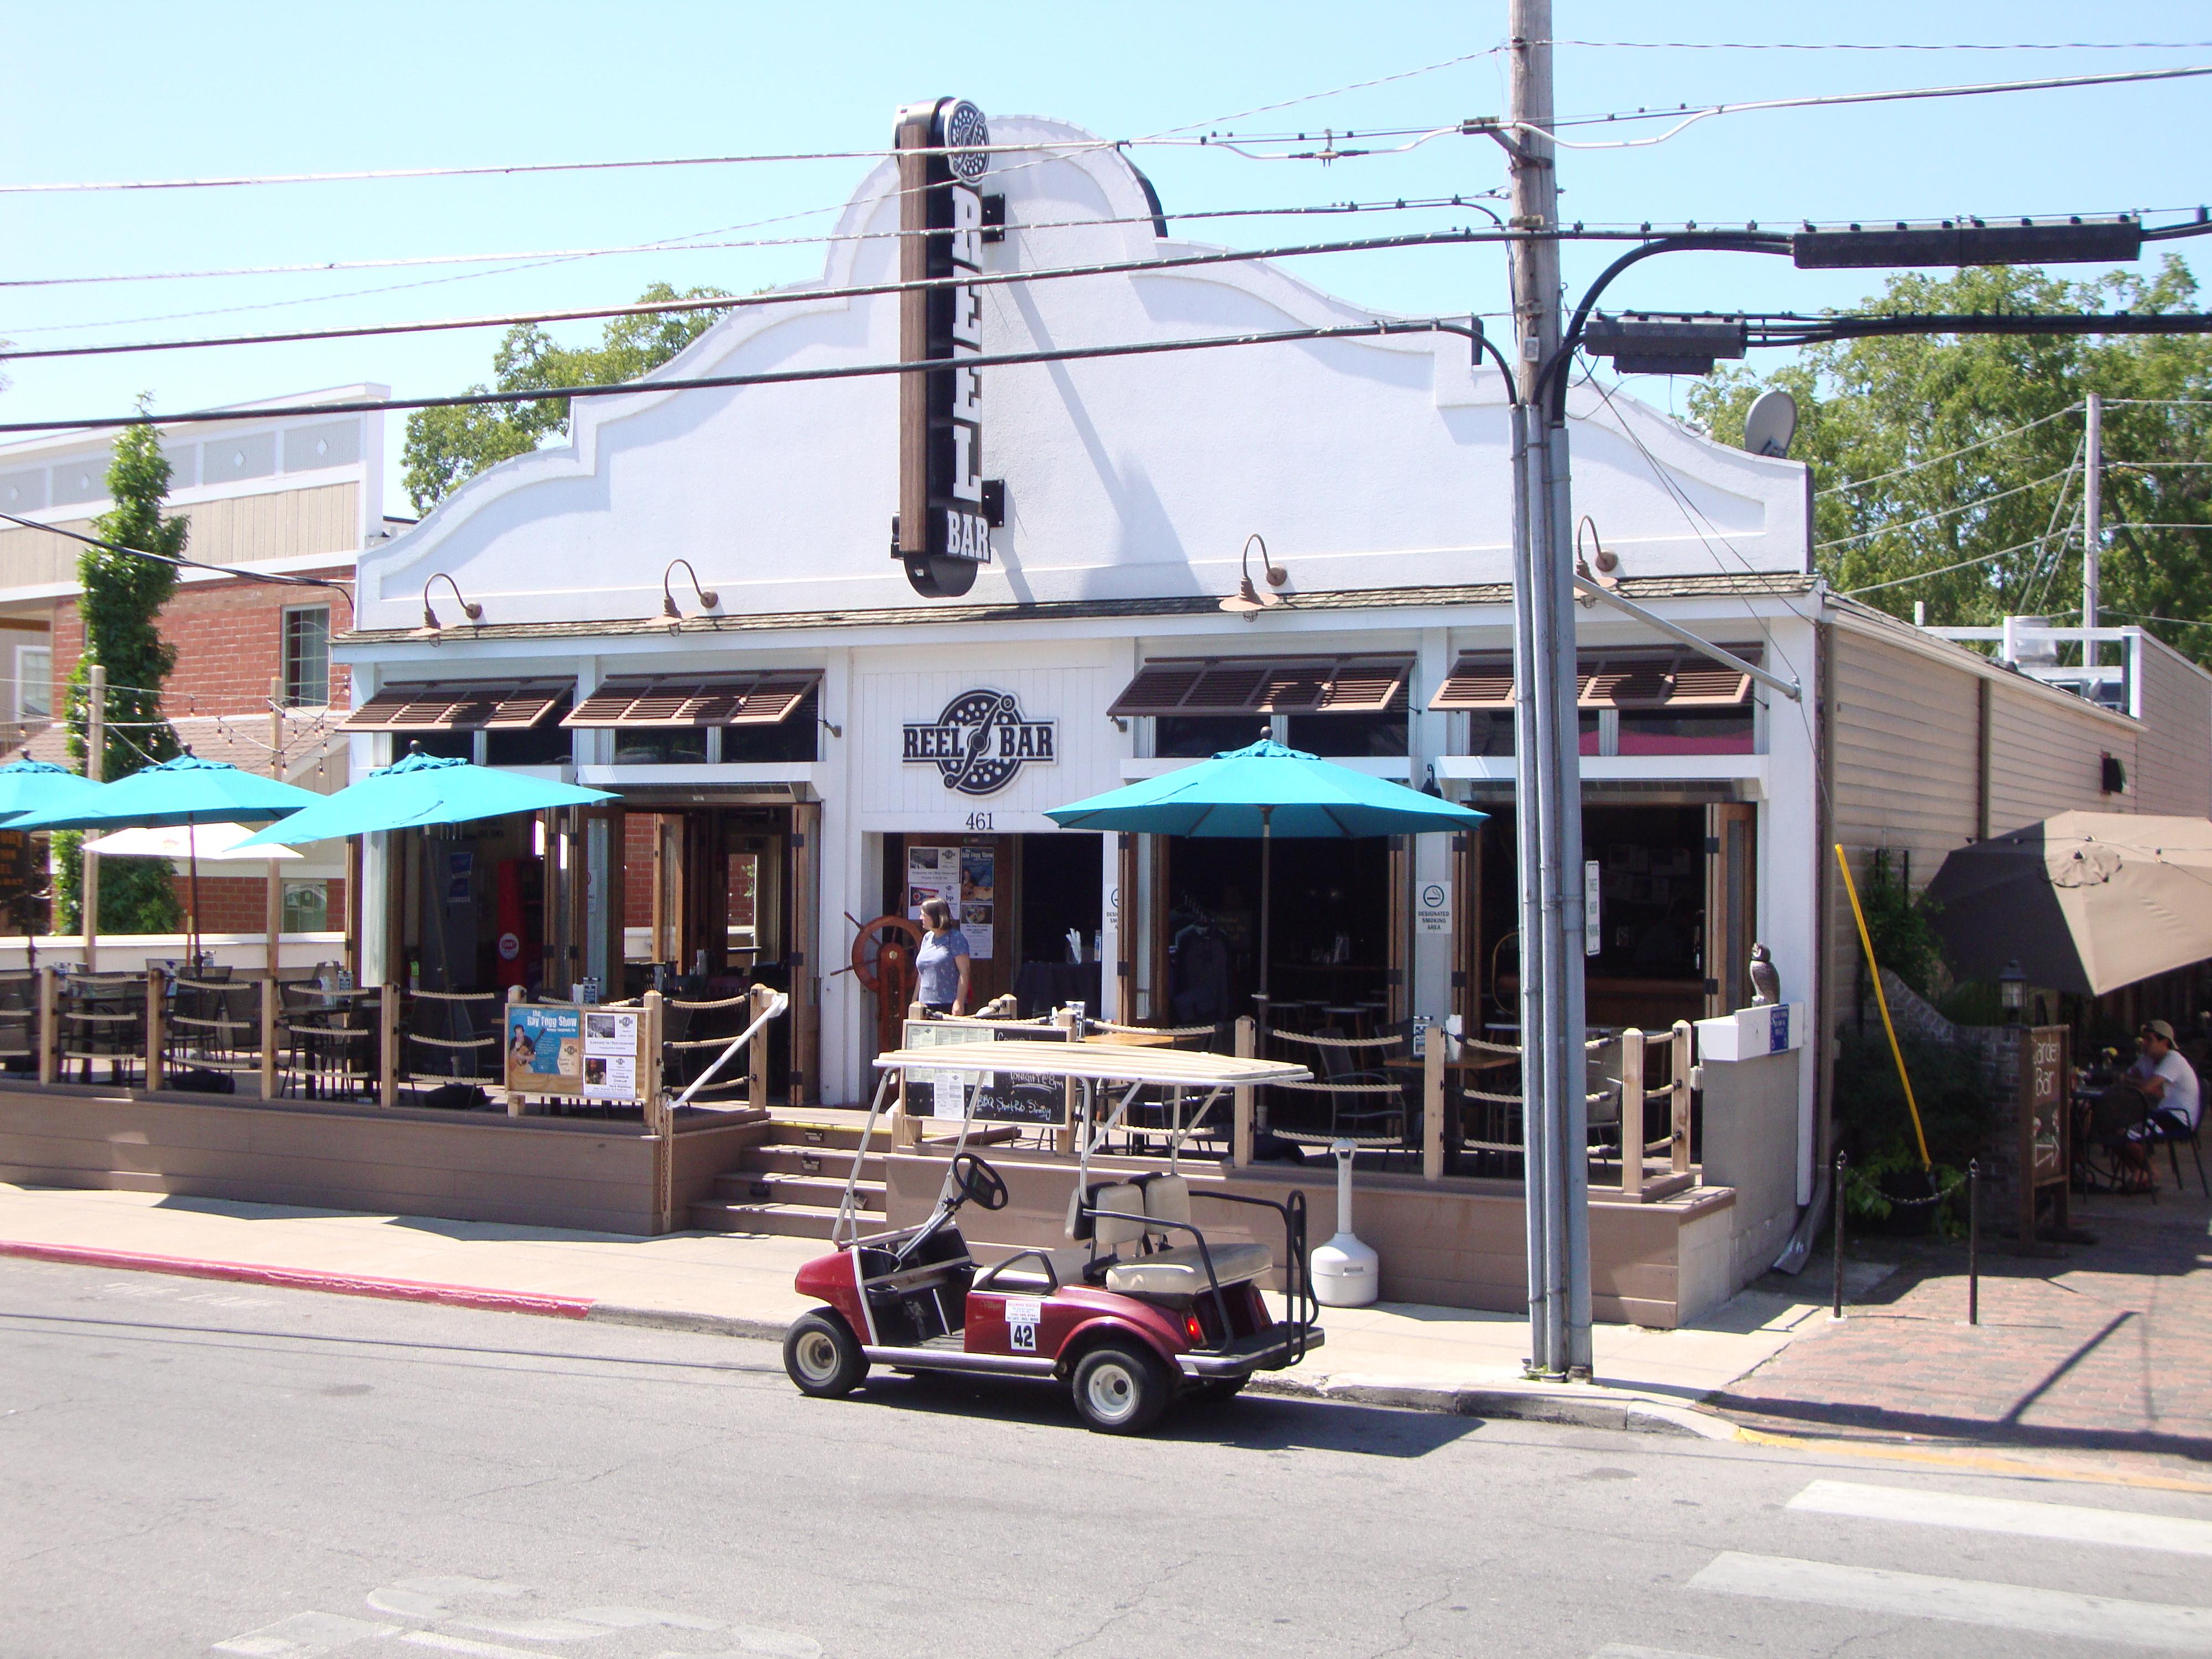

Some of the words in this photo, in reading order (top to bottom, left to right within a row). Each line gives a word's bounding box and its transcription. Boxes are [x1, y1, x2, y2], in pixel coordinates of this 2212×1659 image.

[952, 185, 982, 502] REEL
[947, 509, 990, 563] BAR
[902, 727, 964, 758] REEL
[999, 726, 1053, 757] BAR
[966, 812, 994, 830] 461
[559, 1015, 577, 1027] Show
[2031, 1033, 2060, 1065] arden
[2036, 1067, 2055, 1097] Bar
[976, 1094, 994, 1108] BBQ
[1014, 1324, 1033, 1347] 42
